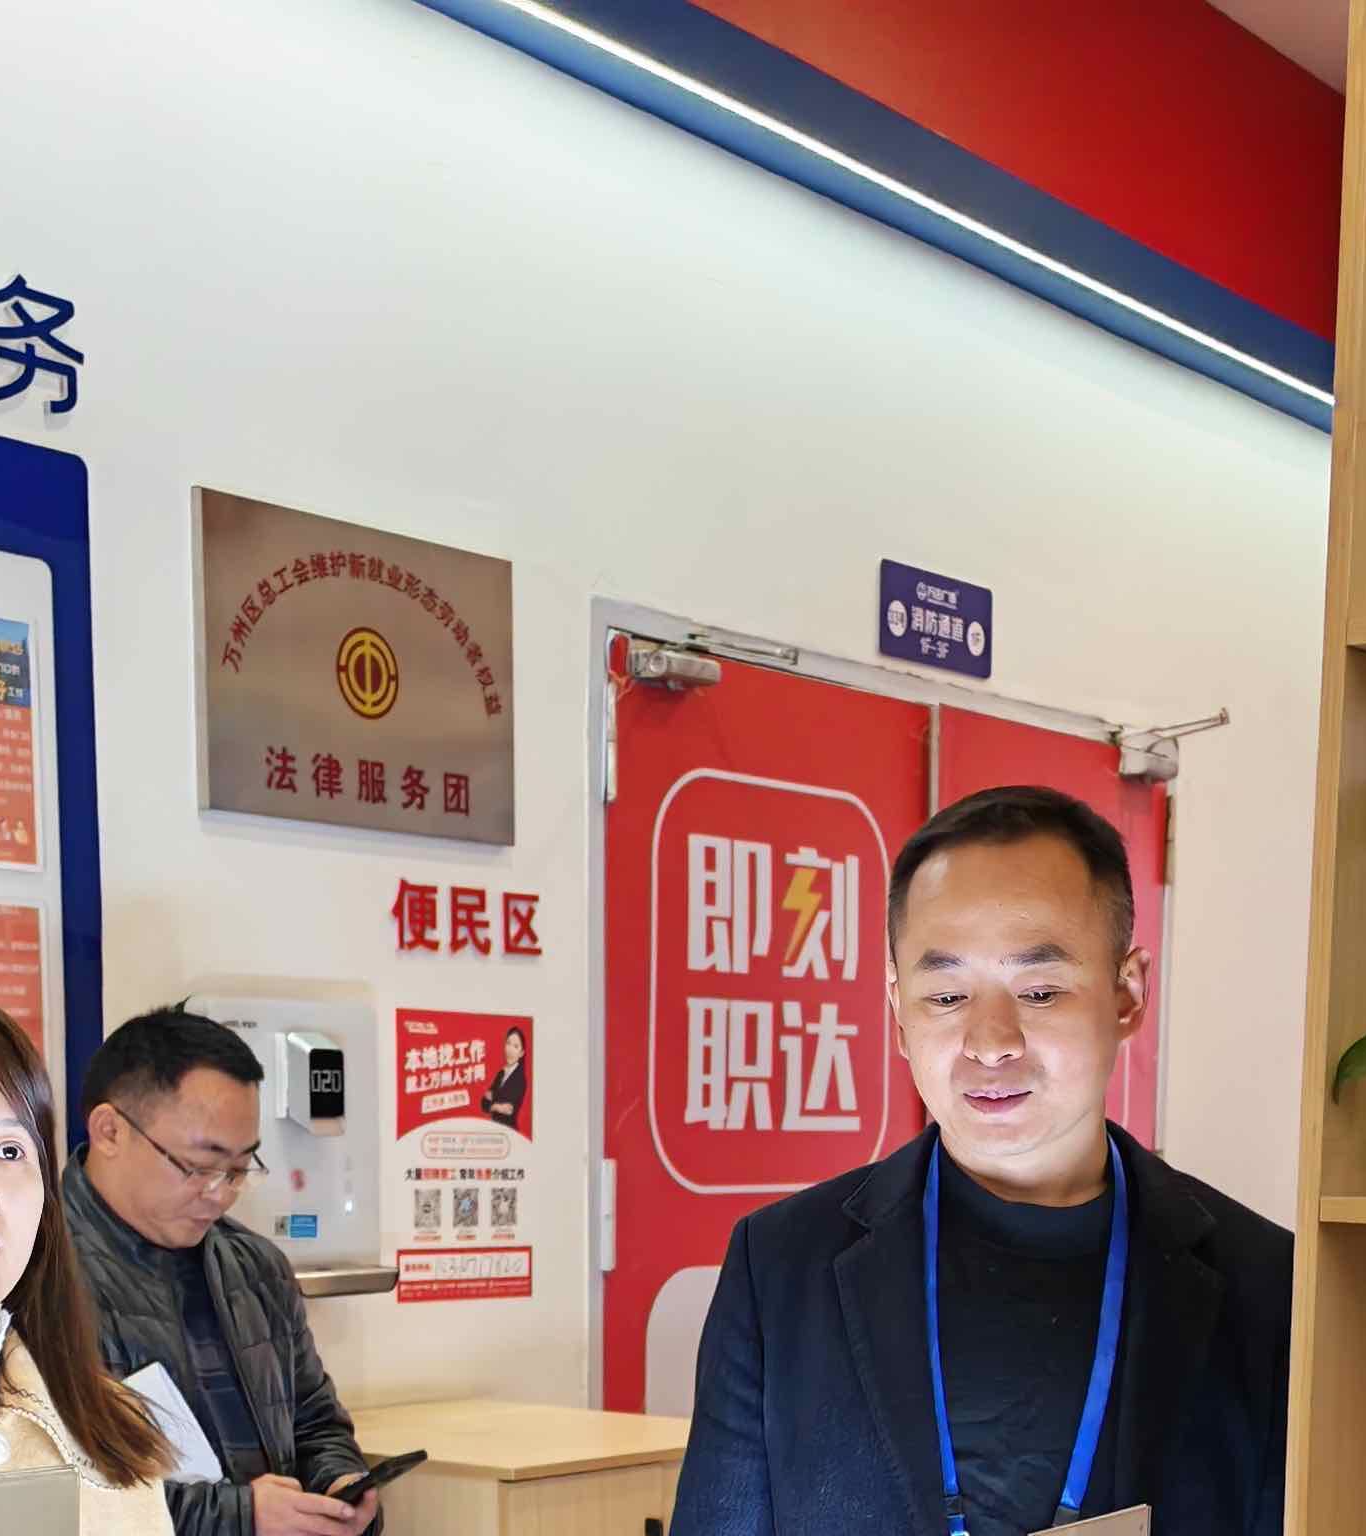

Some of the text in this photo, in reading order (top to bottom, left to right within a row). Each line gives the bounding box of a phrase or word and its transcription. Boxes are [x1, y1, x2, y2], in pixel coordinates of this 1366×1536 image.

[265, 745, 471, 817] 法律服务团
[392, 878, 543, 956] 便民区
[687, 833, 860, 982] 即刻
[404, 1039, 486, 1072] 本地找工作
[685, 996, 861, 1132] 职达
